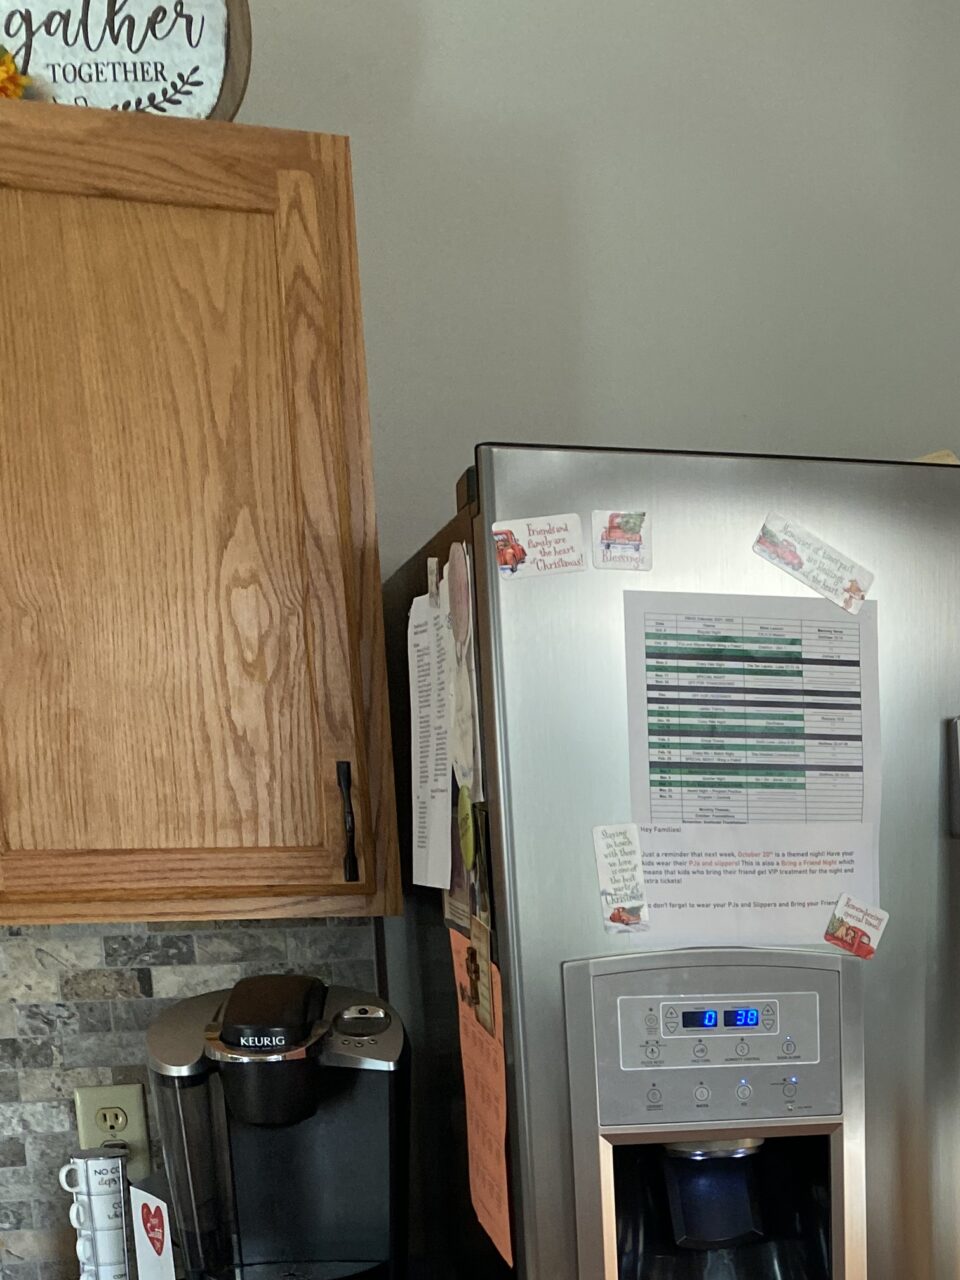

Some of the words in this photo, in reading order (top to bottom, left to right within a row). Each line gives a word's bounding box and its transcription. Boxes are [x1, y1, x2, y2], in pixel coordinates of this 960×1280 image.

[46, 61, 168, 84] TOGETHER
[539, 546, 552, 558] the
[554, 545, 575, 555] heart
[535, 553, 584, 572] Christmas!
[640, 826, 652, 834] Hey
[719, 851, 737, 859] week,
[781, 860, 797, 868] Bring
[823, 859, 837, 867] Night
[706, 869, 722, 877] bring
[828, 868, 842, 876] night
[753, 901, 777, 909] Slippers
[807, 901, 819, 909] your
[704, 1011, 716, 1026] 0
[736, 1009, 758, 1025] 38
[240, 1036, 285, 1046] KEURIG
[94, 1168, 109, 1176] NO
